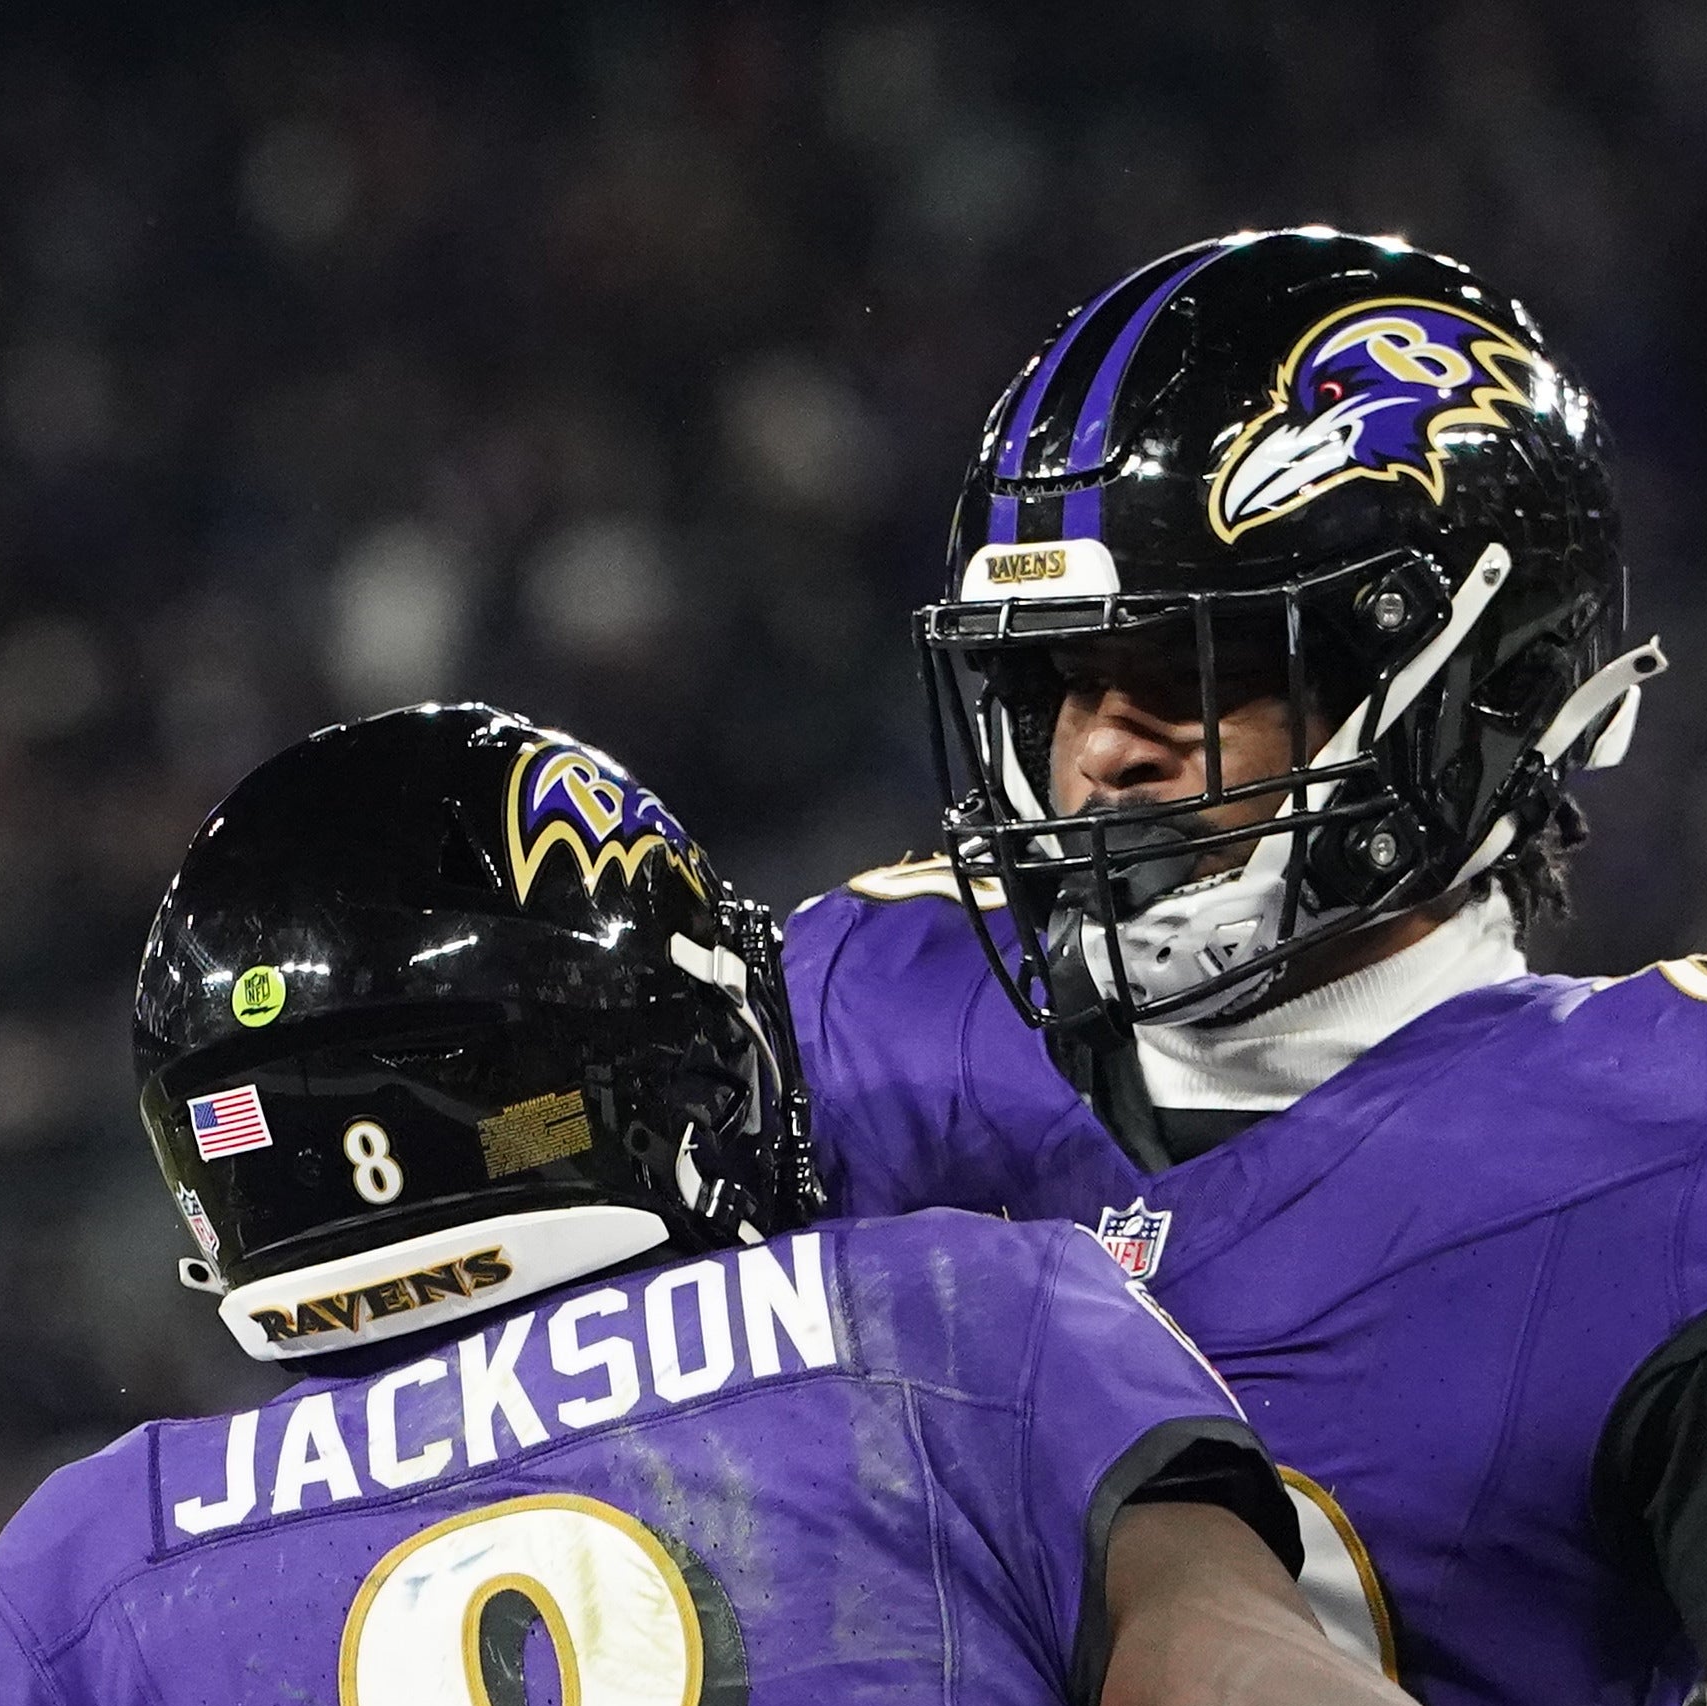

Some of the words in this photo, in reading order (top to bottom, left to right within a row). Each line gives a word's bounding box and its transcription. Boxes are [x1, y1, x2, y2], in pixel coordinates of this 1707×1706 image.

[1312, 317, 1473, 389] B
[986, 549, 1067, 584] RAVENS
[533, 753, 625, 843] B
[247, 984, 270, 1003] NFL
[343, 1115, 404, 1205] 8
[249, 1245, 514, 1342] RAVENS
[174, 1233, 839, 1535] JACKSON
